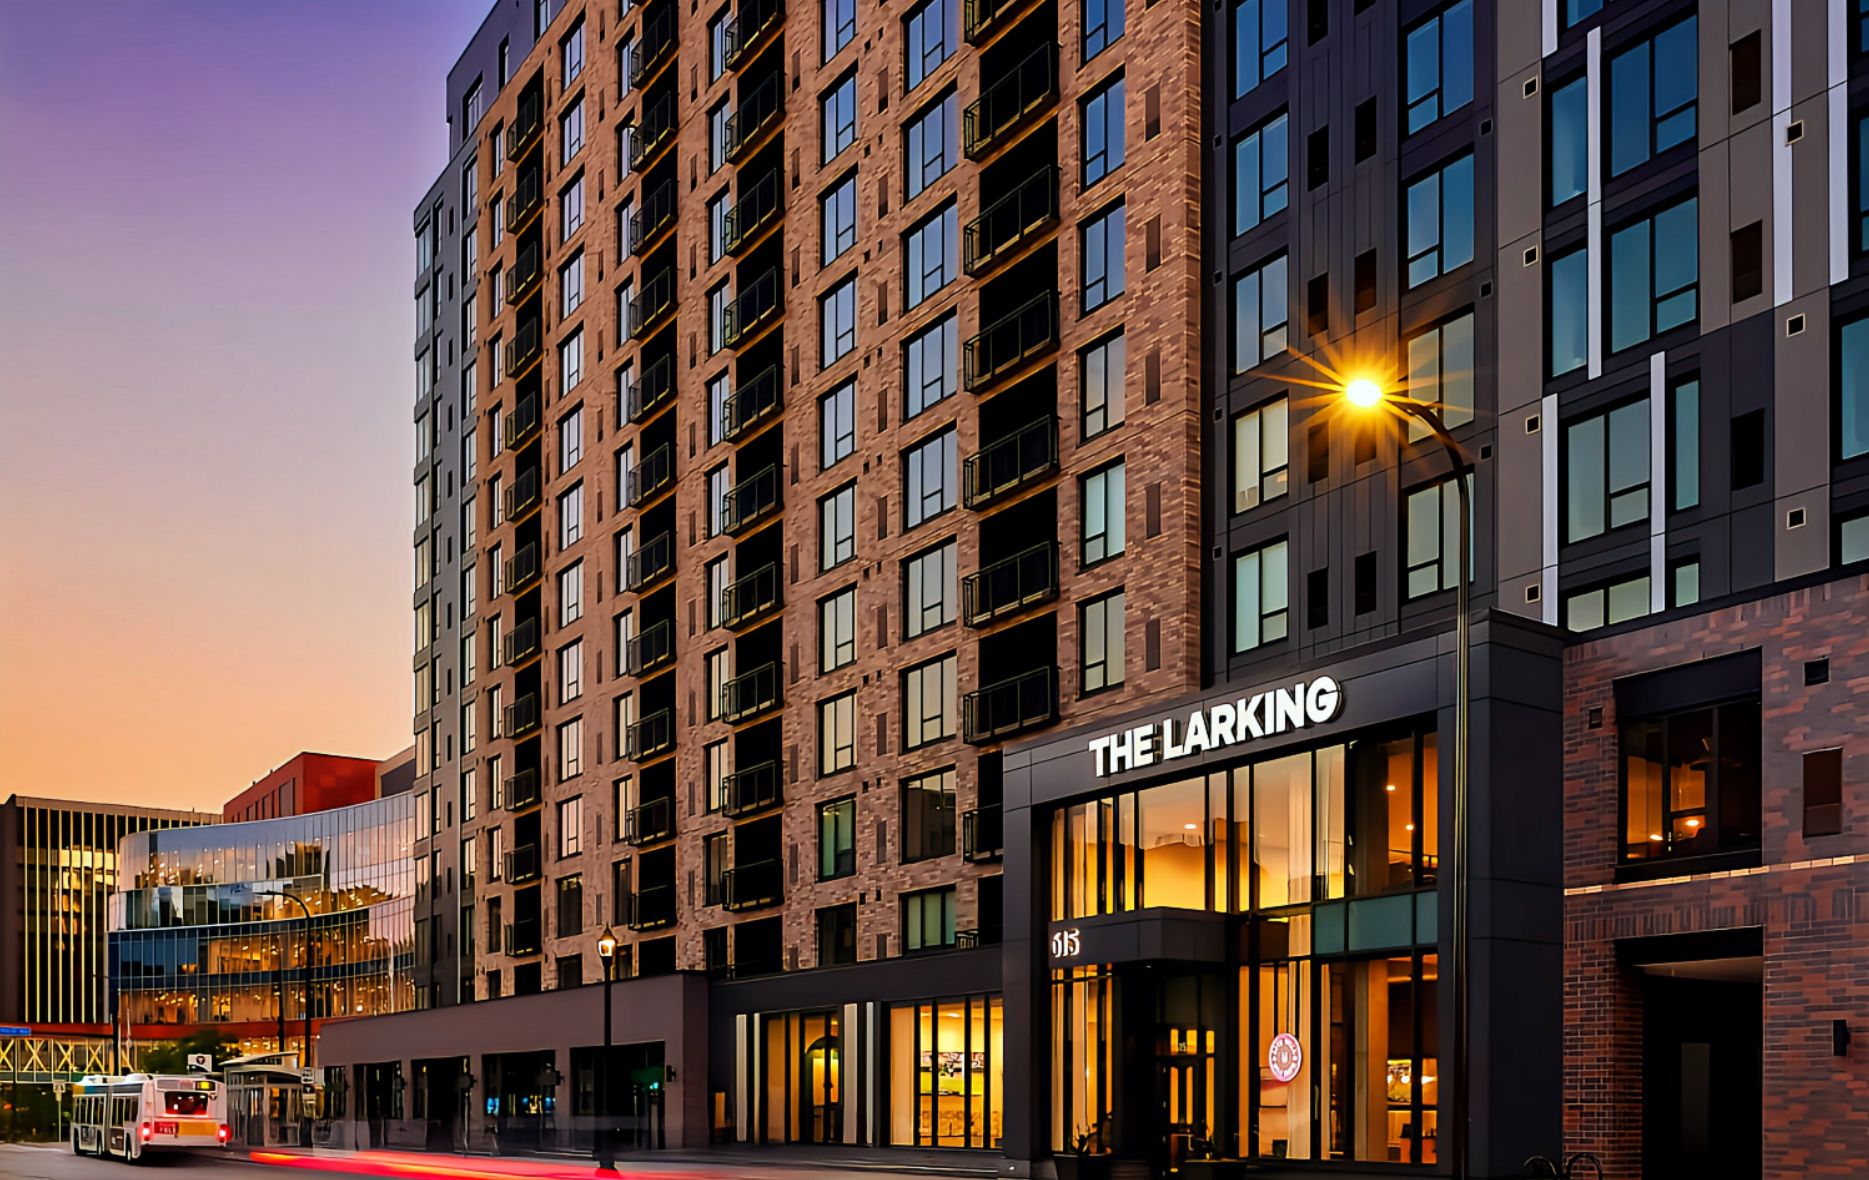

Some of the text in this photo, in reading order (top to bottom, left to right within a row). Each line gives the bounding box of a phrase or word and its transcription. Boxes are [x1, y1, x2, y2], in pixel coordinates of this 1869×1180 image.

[1088, 675, 1341, 778] THE LARKING
[1052, 928, 1081, 958] 615
